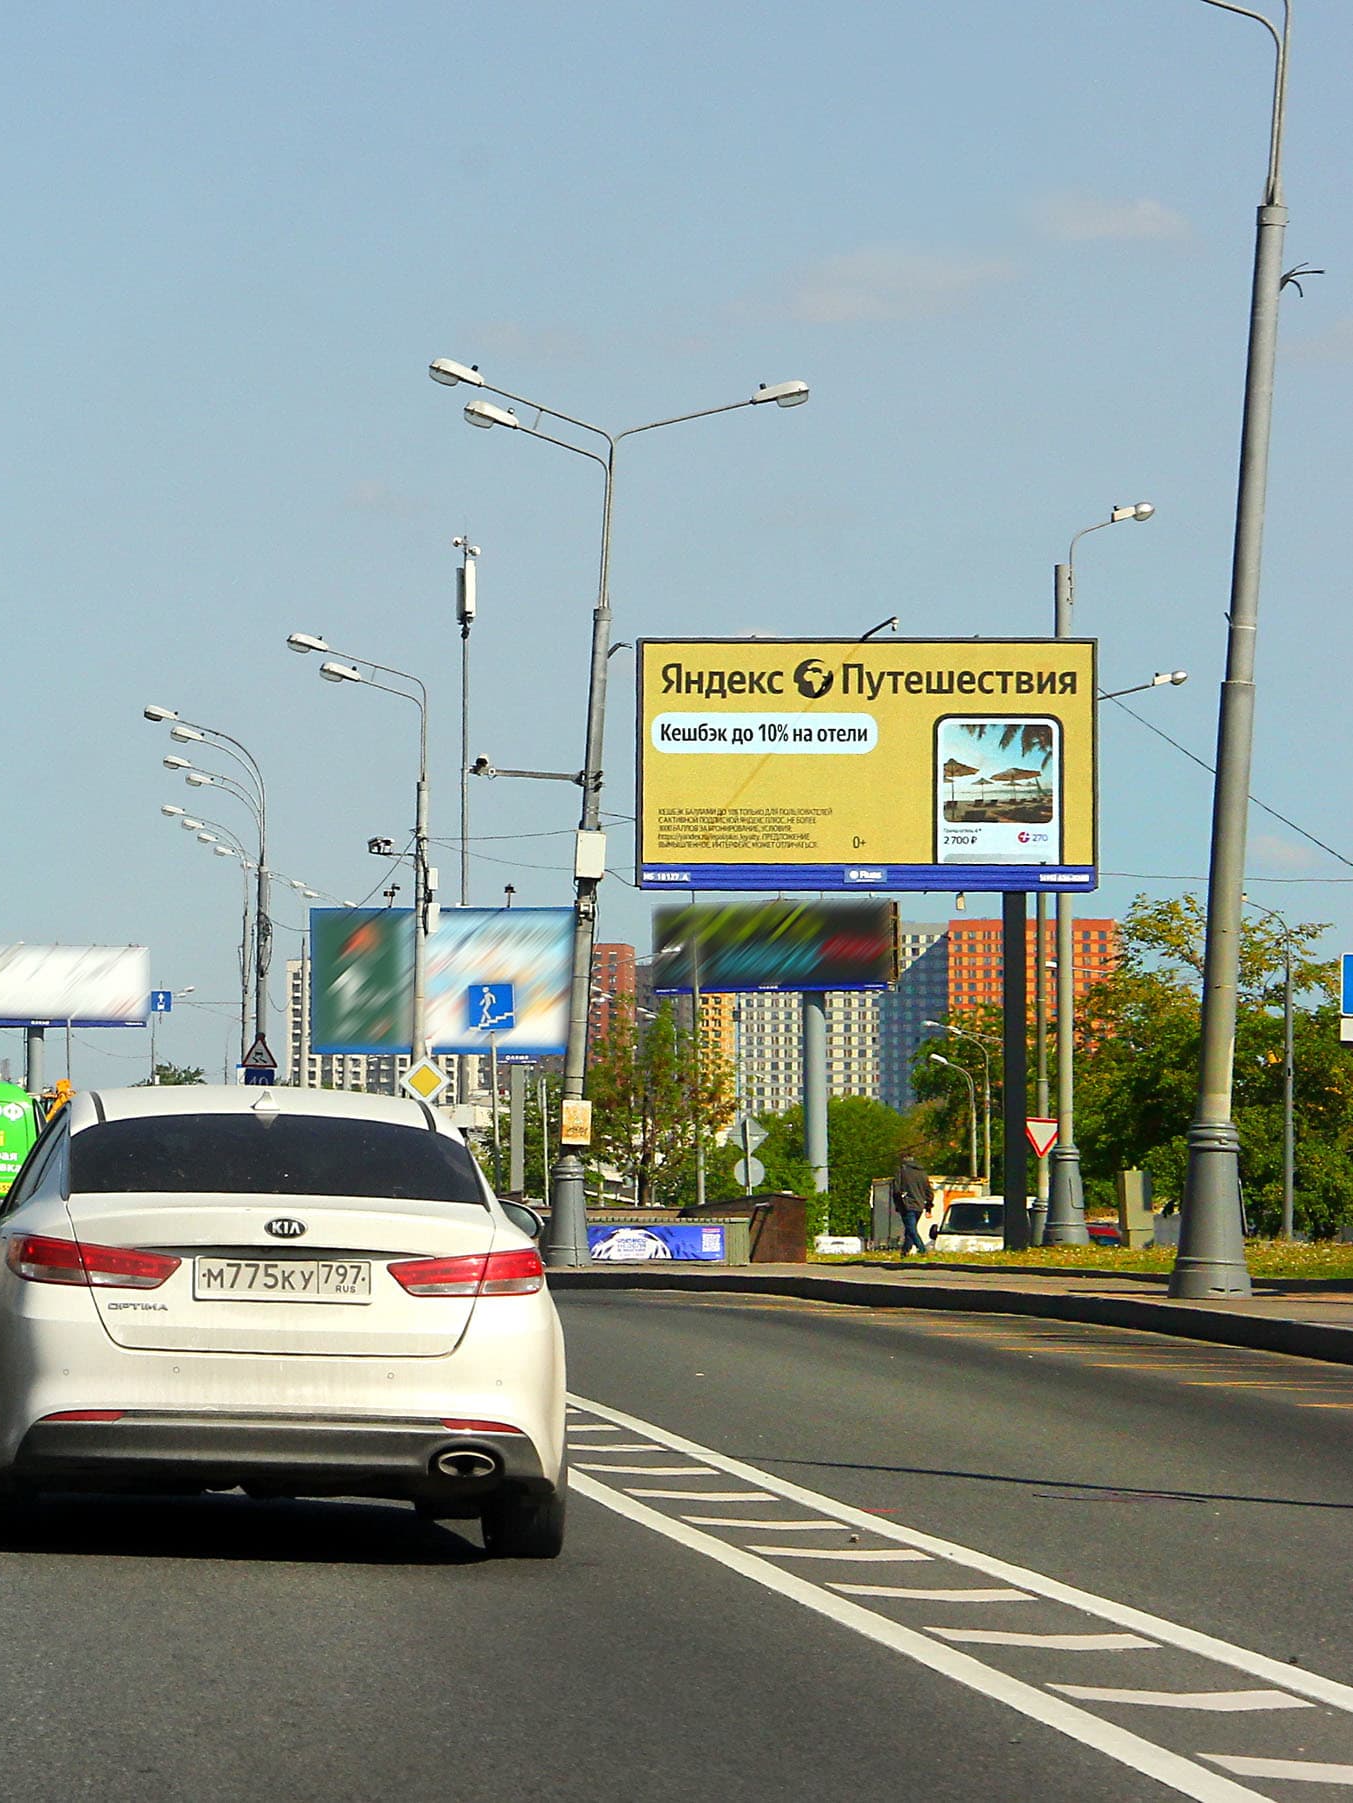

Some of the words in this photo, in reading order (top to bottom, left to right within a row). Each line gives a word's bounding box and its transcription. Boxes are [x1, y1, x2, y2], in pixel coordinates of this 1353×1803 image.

[661, 662, 784, 699] Яндекс
[842, 663, 1077, 701] Путешествия
[660, 723, 727, 742] Кешбэк
[732, 728, 753, 744] до
[758, 723, 789, 742] 10%
[793, 728, 813, 742] на
[817, 728, 868, 742] отели
[852, 835, 866, 849] 0+
[1032, 833, 1048, 842] 270
[271, 1221, 301, 1235] KIA
[206, 1263, 315, 1291] М775КУ
[321, 1264, 362, 1285] 797
[335, 1284, 357, 1294] RUS
[107, 1302, 168, 1311] OPTIMA
